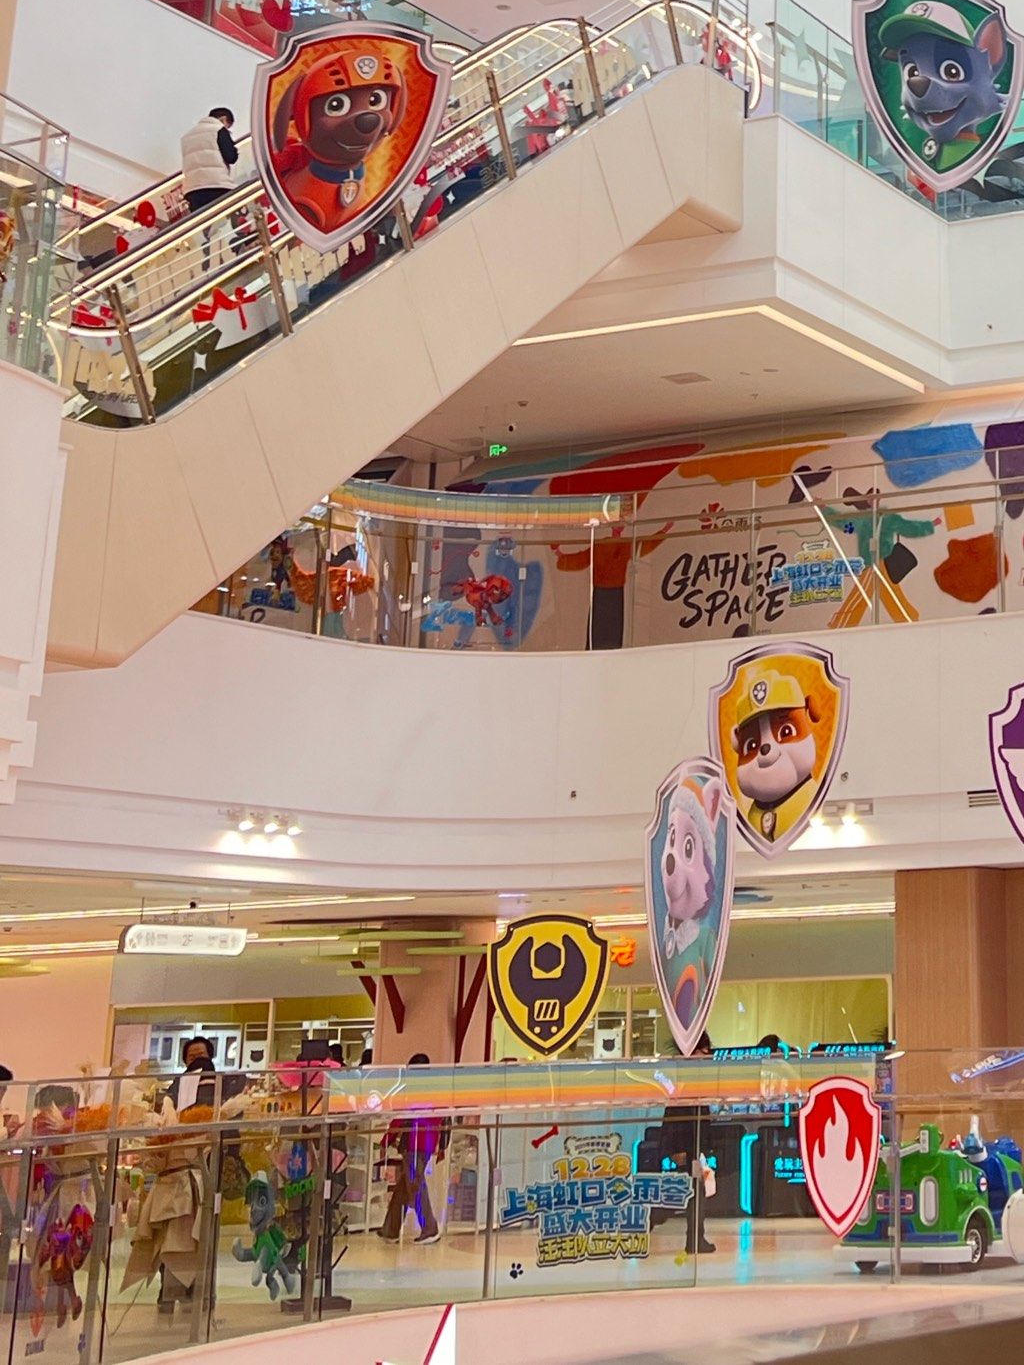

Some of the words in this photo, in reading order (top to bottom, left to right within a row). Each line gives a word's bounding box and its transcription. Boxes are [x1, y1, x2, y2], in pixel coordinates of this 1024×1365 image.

[661, 544, 788, 601] GATHER
[678, 586, 790, 629] SPACE
[553, 1155, 632, 1180] 12.28
[502, 1176, 690, 1219] 上海虹口今雨荟
[543, 1205, 646, 1236] 盛大开业
